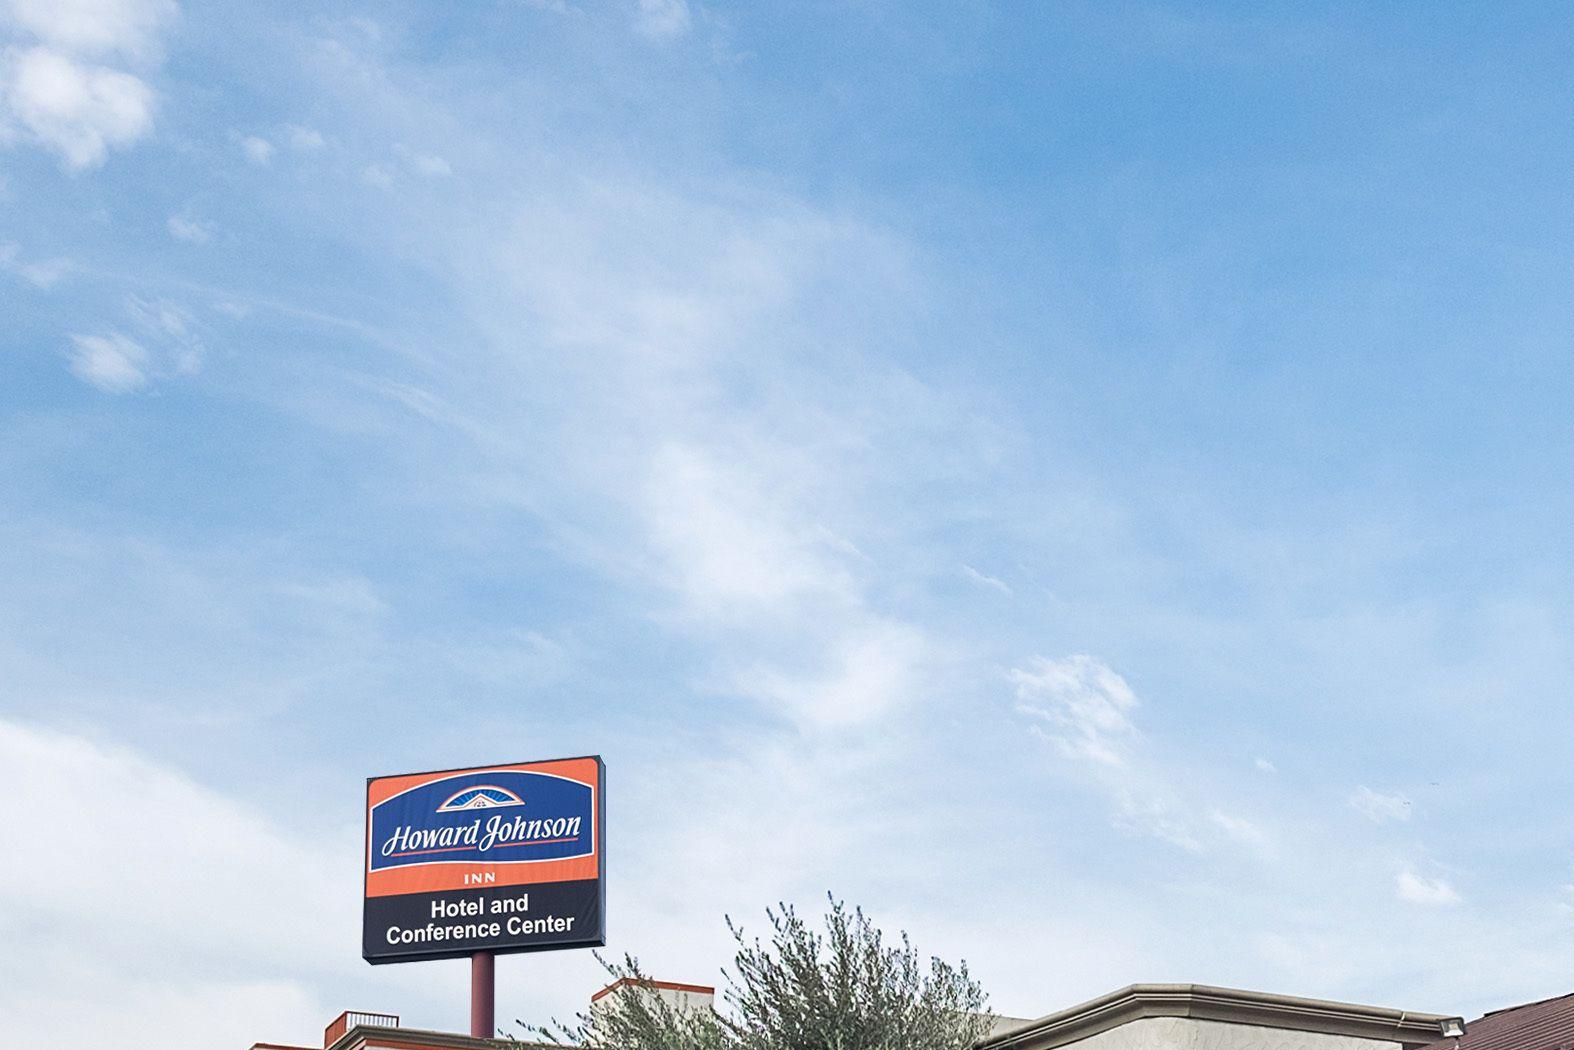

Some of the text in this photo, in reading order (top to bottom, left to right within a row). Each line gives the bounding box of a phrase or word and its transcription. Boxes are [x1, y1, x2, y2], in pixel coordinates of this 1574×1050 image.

[382, 815, 582, 856] Howard Johnson
[464, 872, 496, 885] INN
[431, 894, 529, 919] Hotel and
[386, 915, 575, 945] Conference Center
